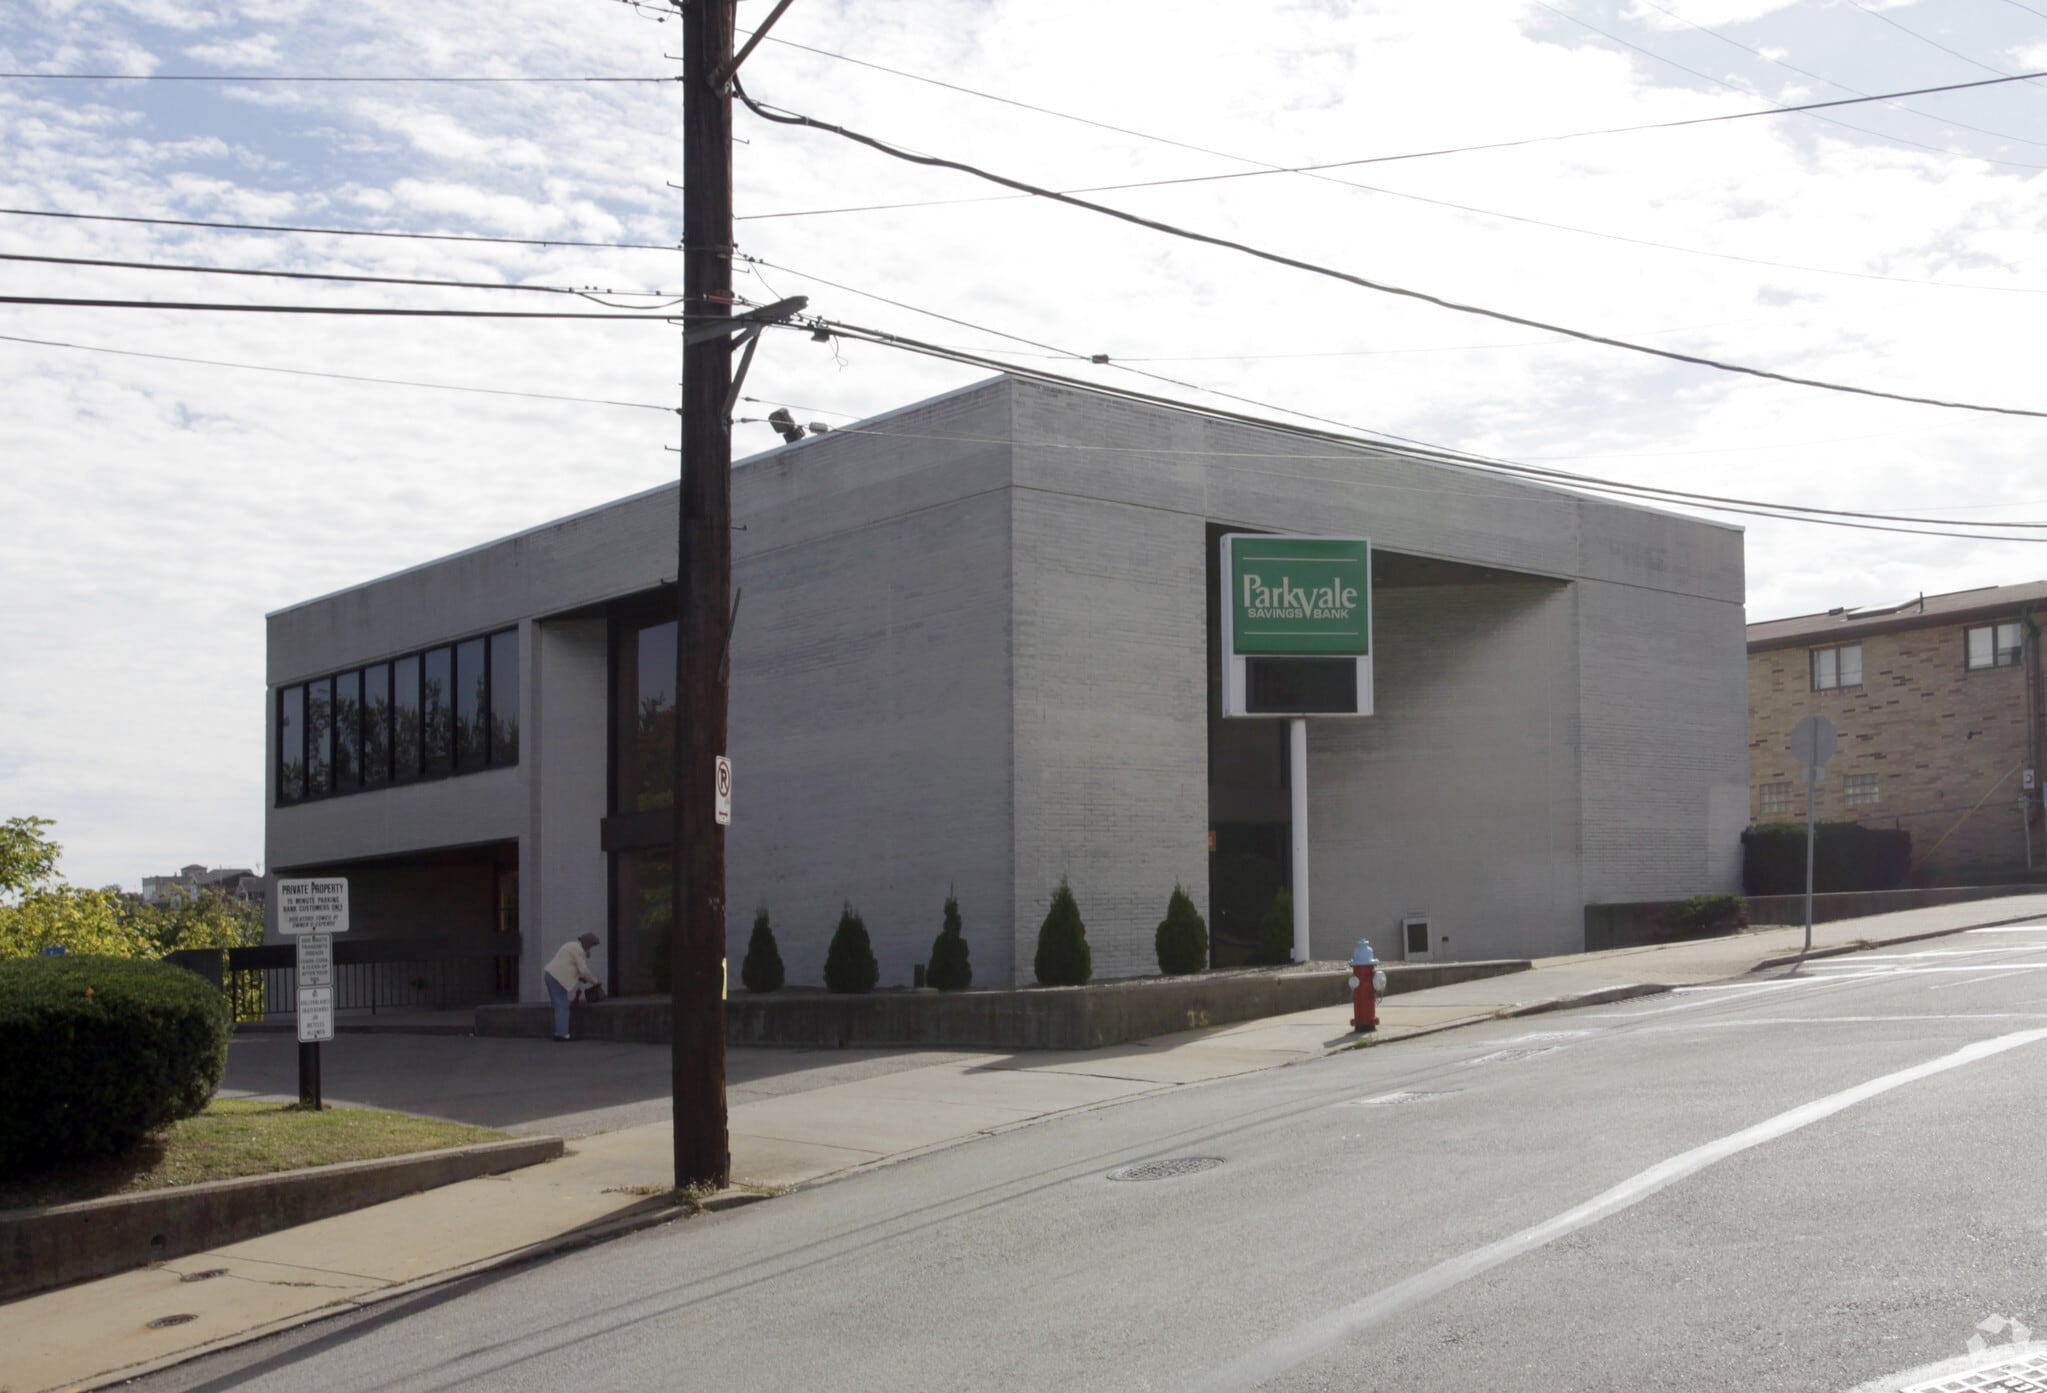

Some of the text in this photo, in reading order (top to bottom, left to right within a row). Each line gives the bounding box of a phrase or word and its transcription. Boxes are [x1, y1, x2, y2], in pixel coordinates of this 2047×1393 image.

[1248, 608, 1349, 618] SAVINGS BANK
[282, 884, 343, 895] PRIVATE PROPERTY
[299, 904, 330, 912] CUSTOMERS
[331, 904, 343, 912] ONLY
